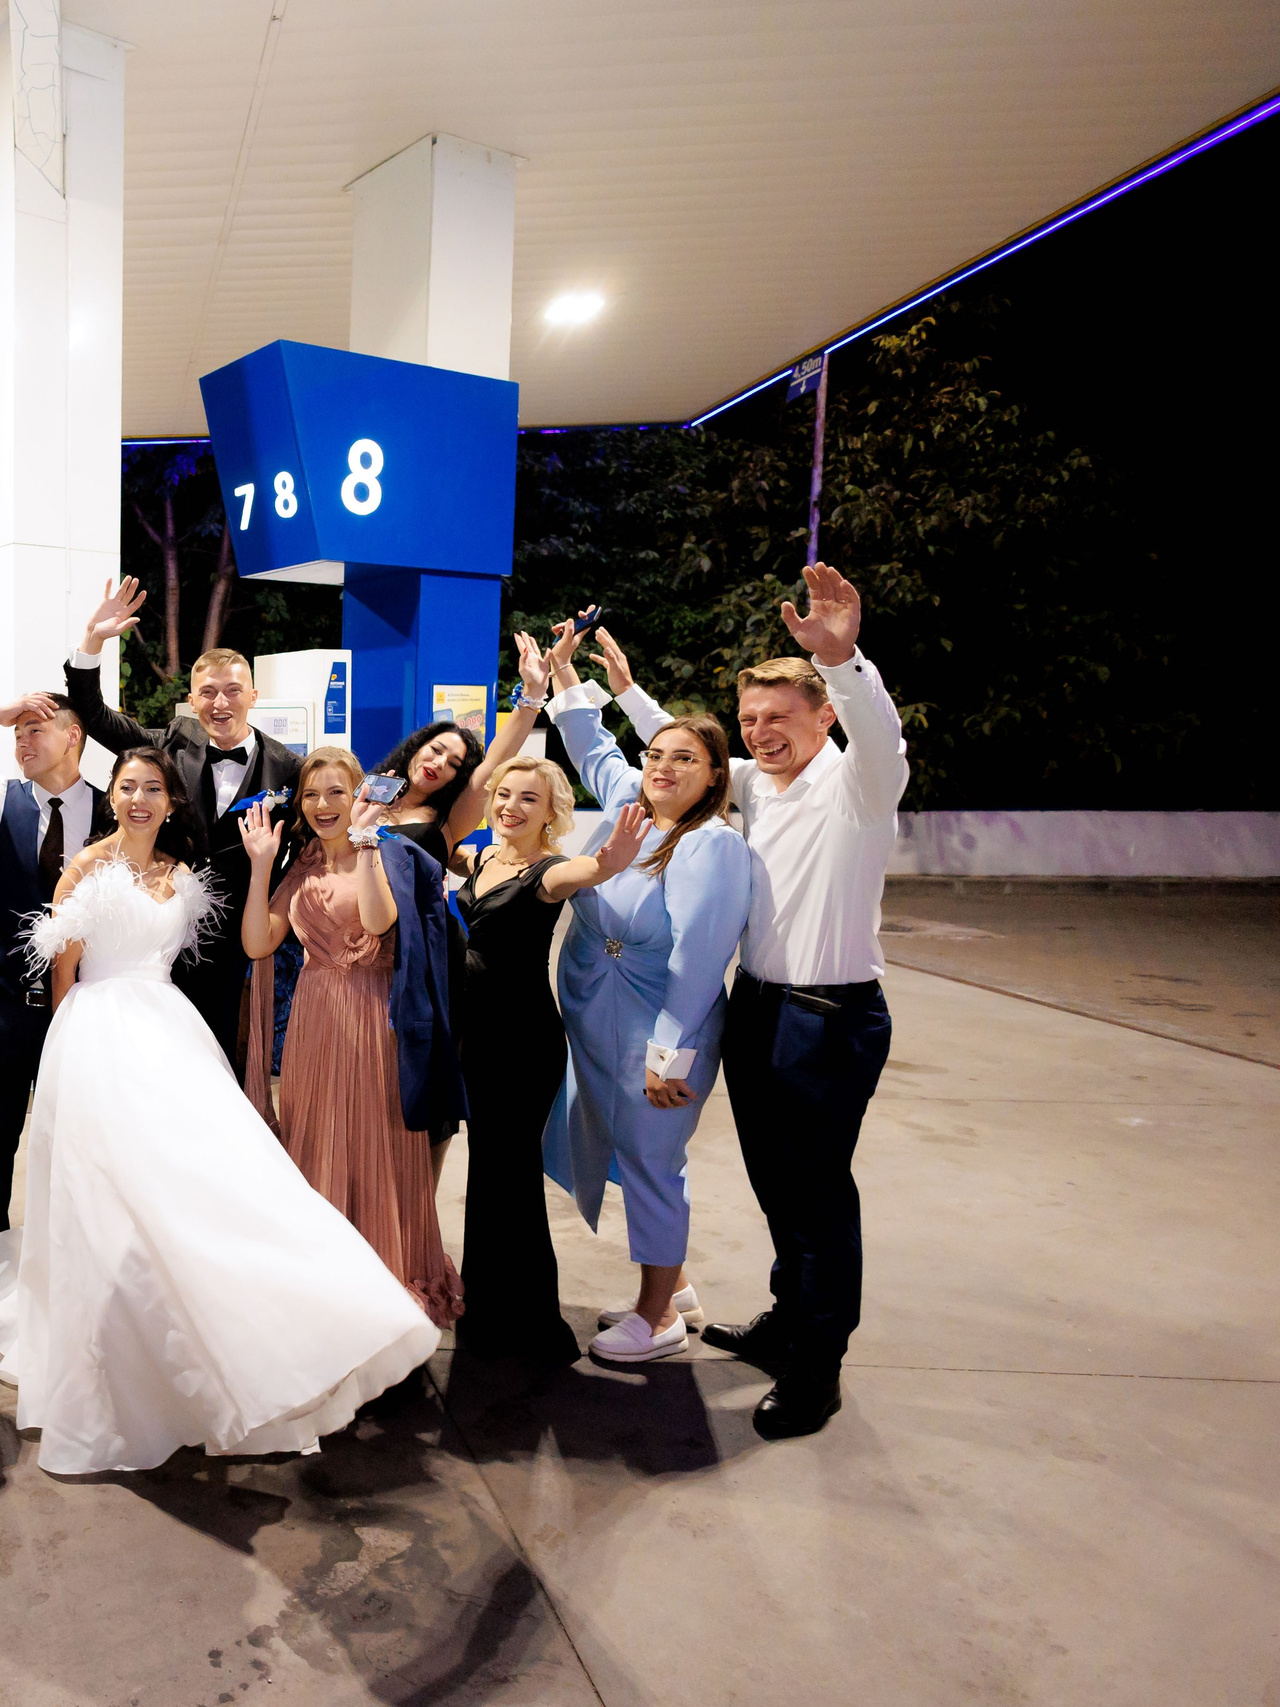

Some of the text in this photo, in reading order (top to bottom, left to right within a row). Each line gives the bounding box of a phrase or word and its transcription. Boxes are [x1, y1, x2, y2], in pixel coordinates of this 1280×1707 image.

[234, 471, 298, 531] 7 8
[341, 438, 384, 516] 8
